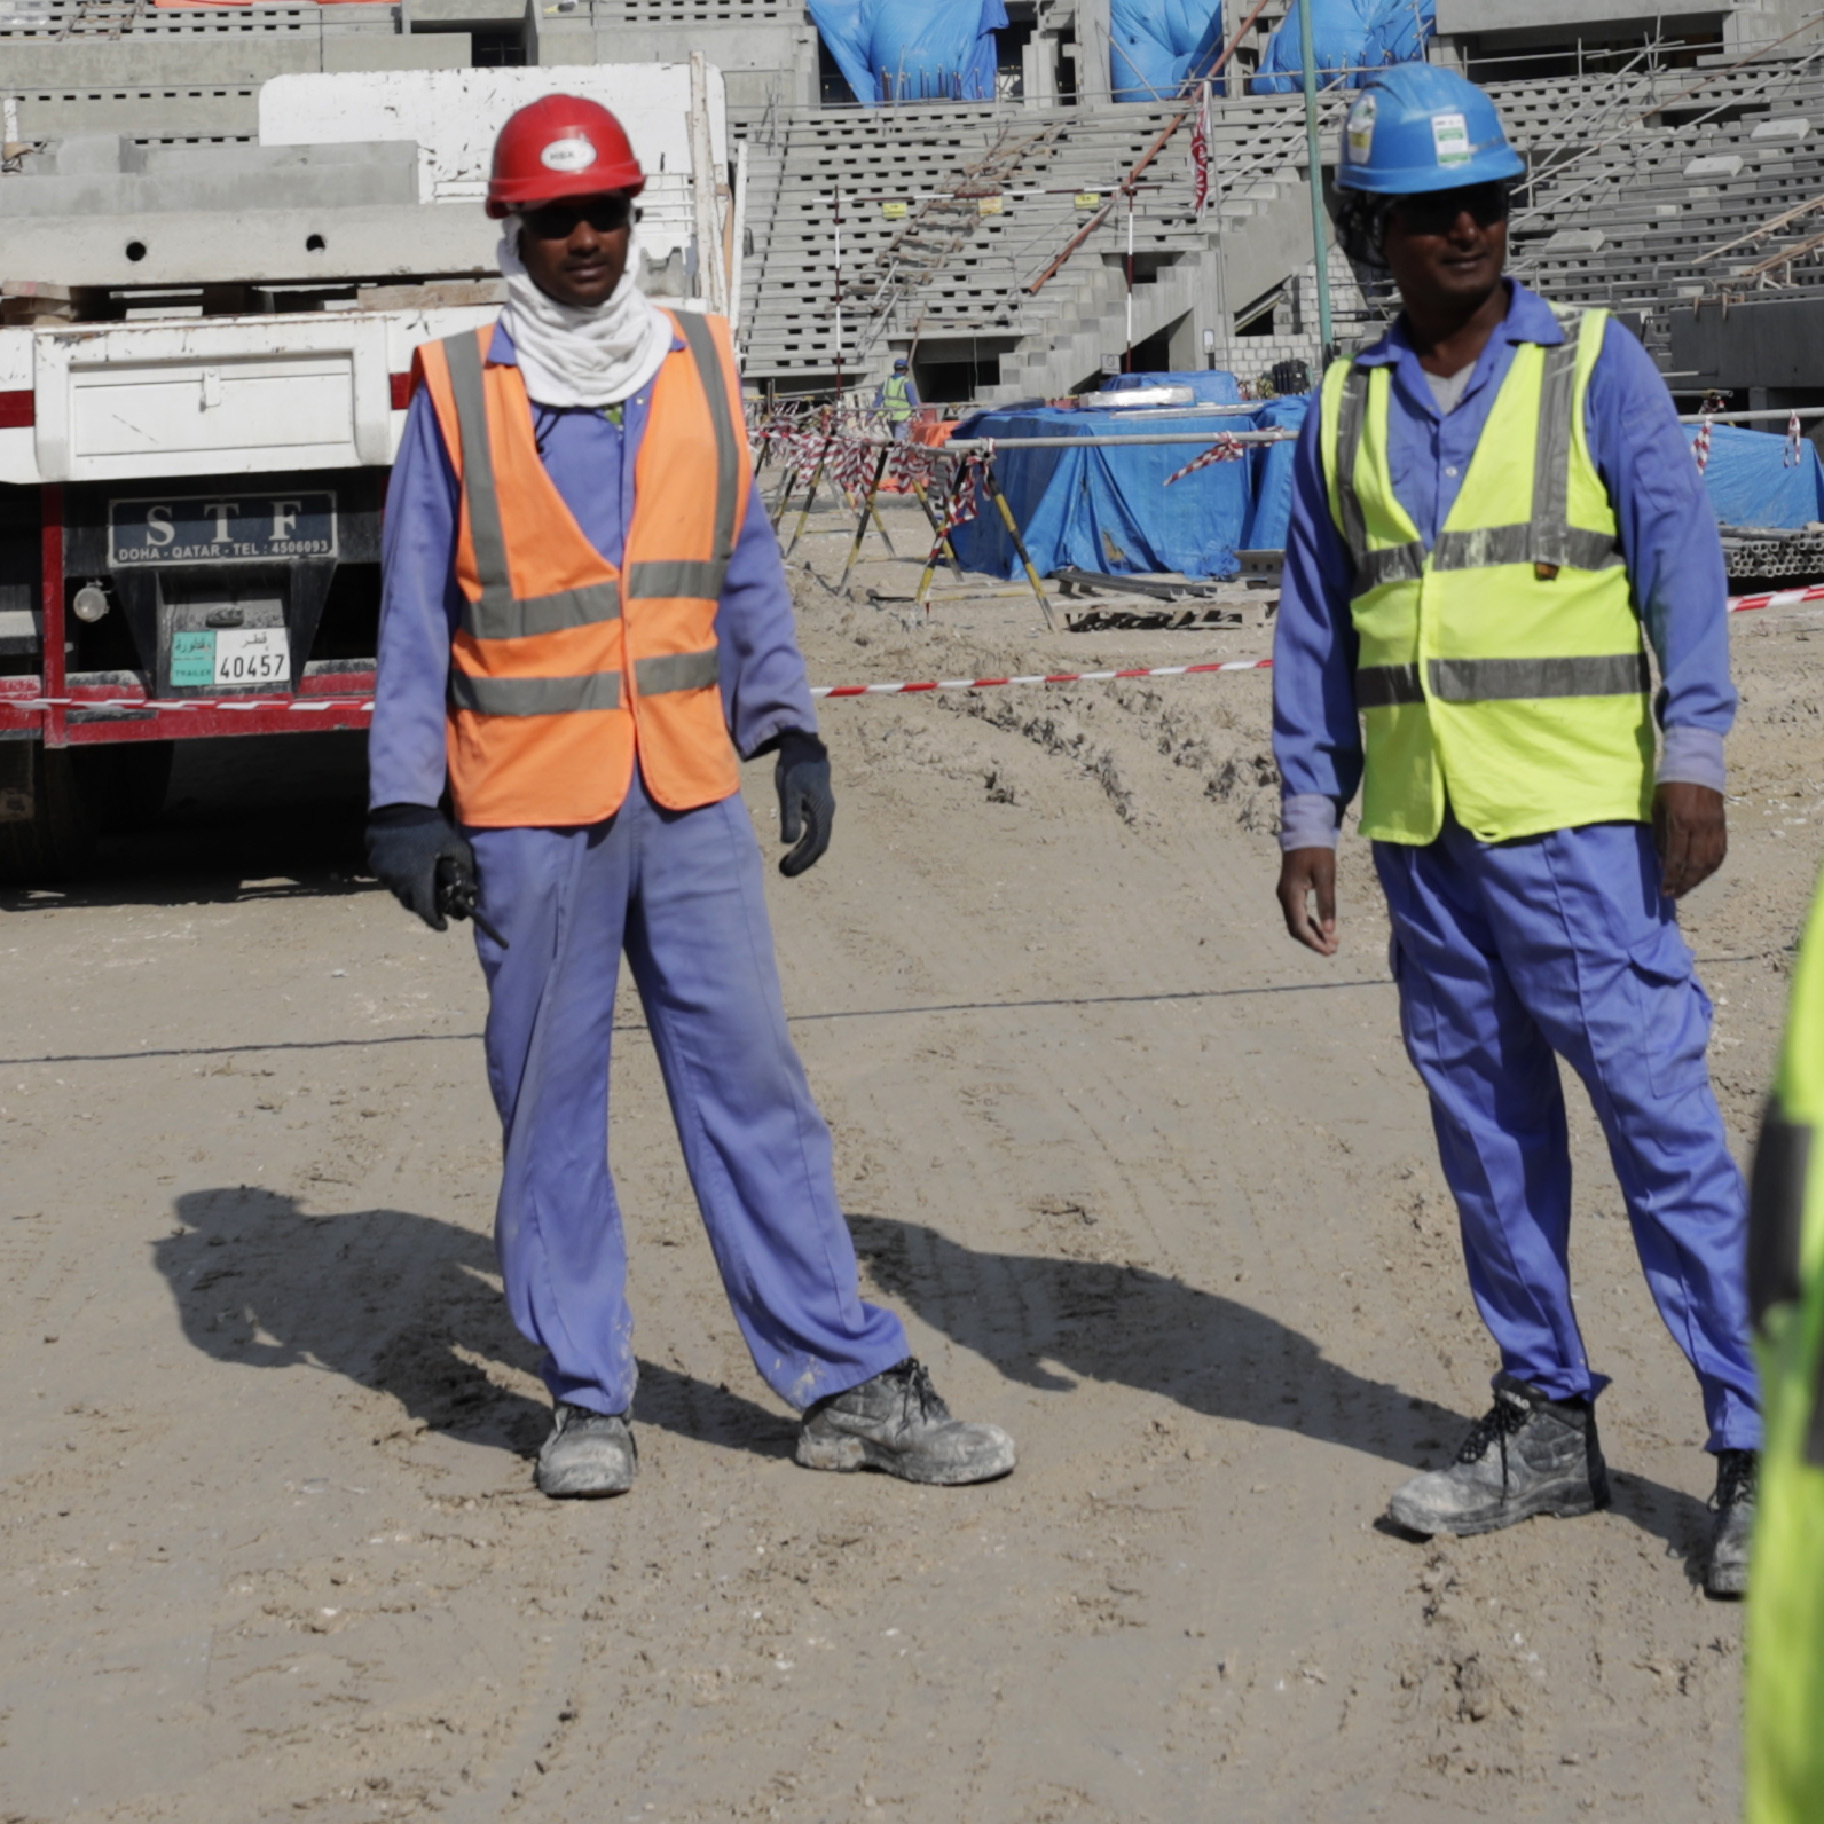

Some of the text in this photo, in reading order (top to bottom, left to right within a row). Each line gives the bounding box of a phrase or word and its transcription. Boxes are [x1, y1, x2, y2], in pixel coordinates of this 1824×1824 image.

[119, 547, 160, 560] DOHA
[172, 544, 220, 559] QATAR
[233, 543, 259, 556] TEL
[271, 540, 328, 554] 4506093
[241, 631, 269, 652] قطر
[219, 654, 284, 678] 40457
